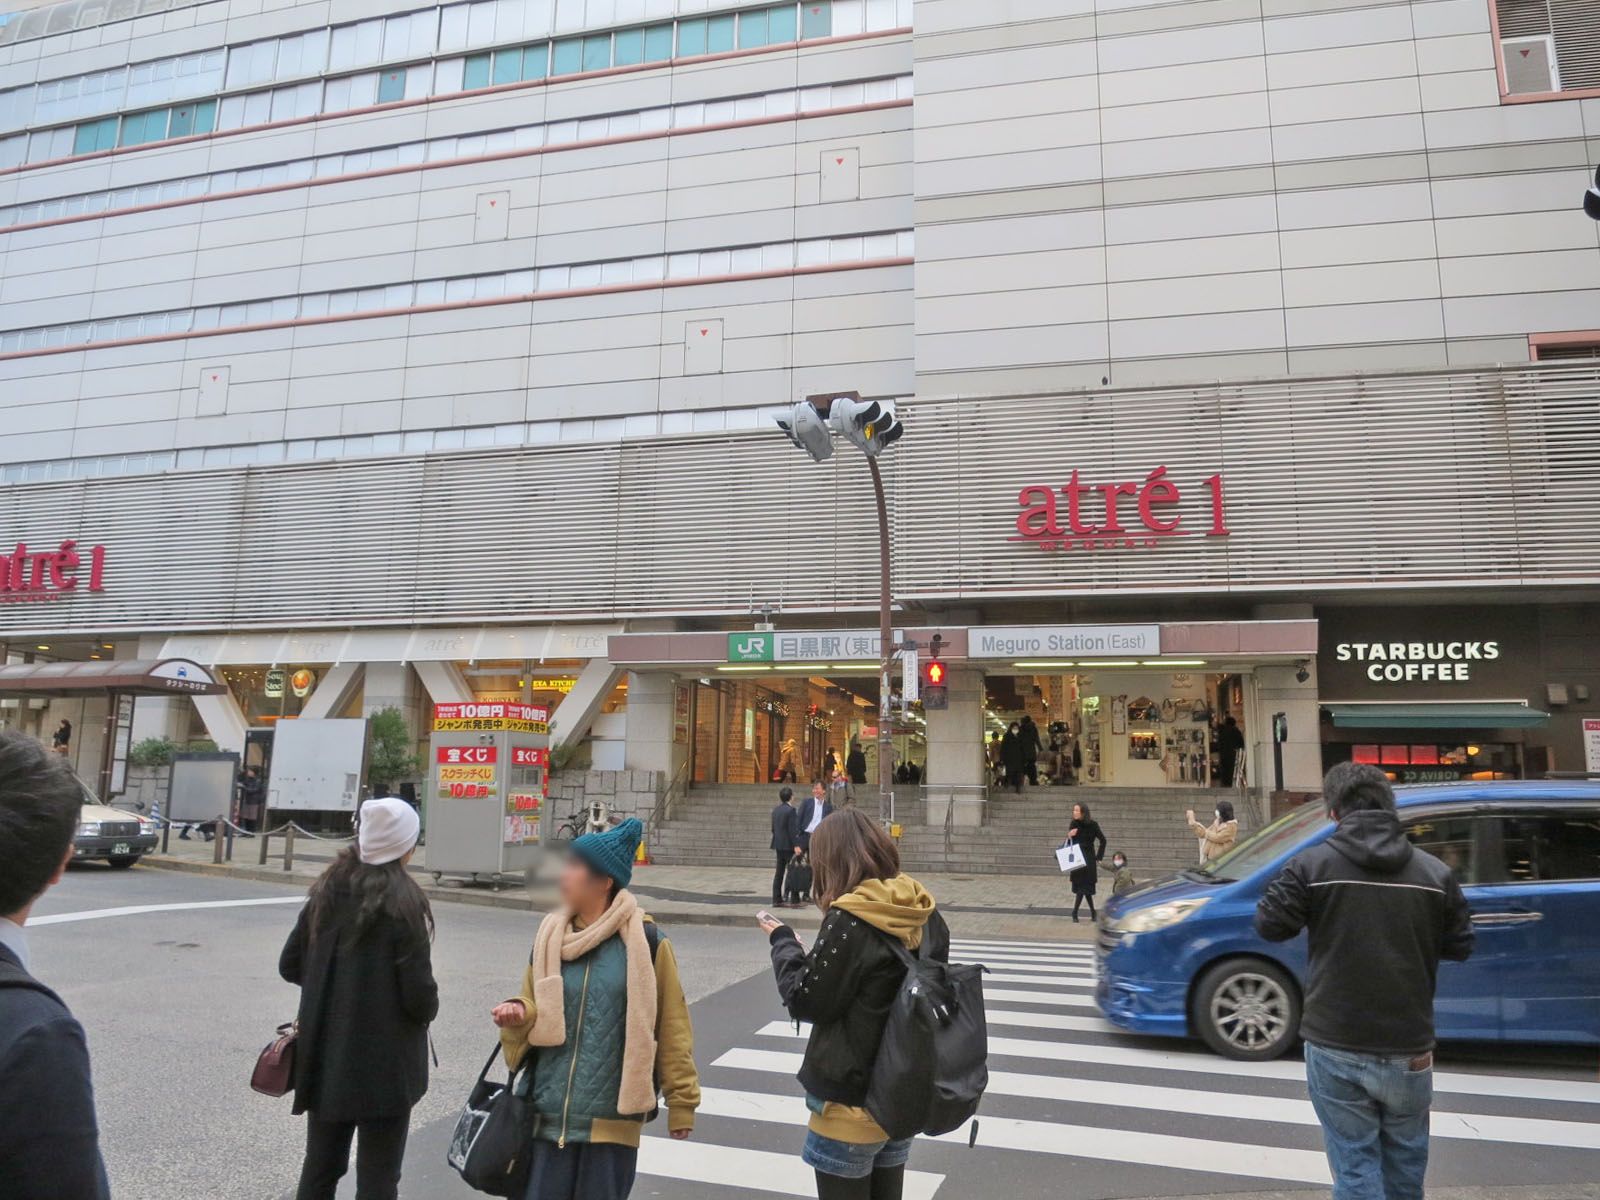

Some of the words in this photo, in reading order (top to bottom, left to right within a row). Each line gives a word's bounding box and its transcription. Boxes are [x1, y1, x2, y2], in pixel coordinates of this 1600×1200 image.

[1015, 465, 1182, 536] atré
[1202, 473, 1230, 536] 1
[88, 545, 106, 592] 1
[738, 637, 765, 654] JR
[781, 636, 882, 658] 目黒駅(東口
[981, 636, 1041, 655] Meguro
[1048, 633, 1105, 651] Station
[1107, 632, 1146, 650] (East)
[1336, 641, 1500, 661] STARBUCKS
[1367, 663, 1470, 682] COFFEE
[458, 704, 504, 718] 10億円
[437, 719, 503, 730] ジャンボ発売中
[447, 748, 488, 763] 宝くじ
[516, 750, 538, 762] 宝くじ
[441, 768, 492, 780] スクラッチくじ
[449, 783, 489, 799] 10億円
